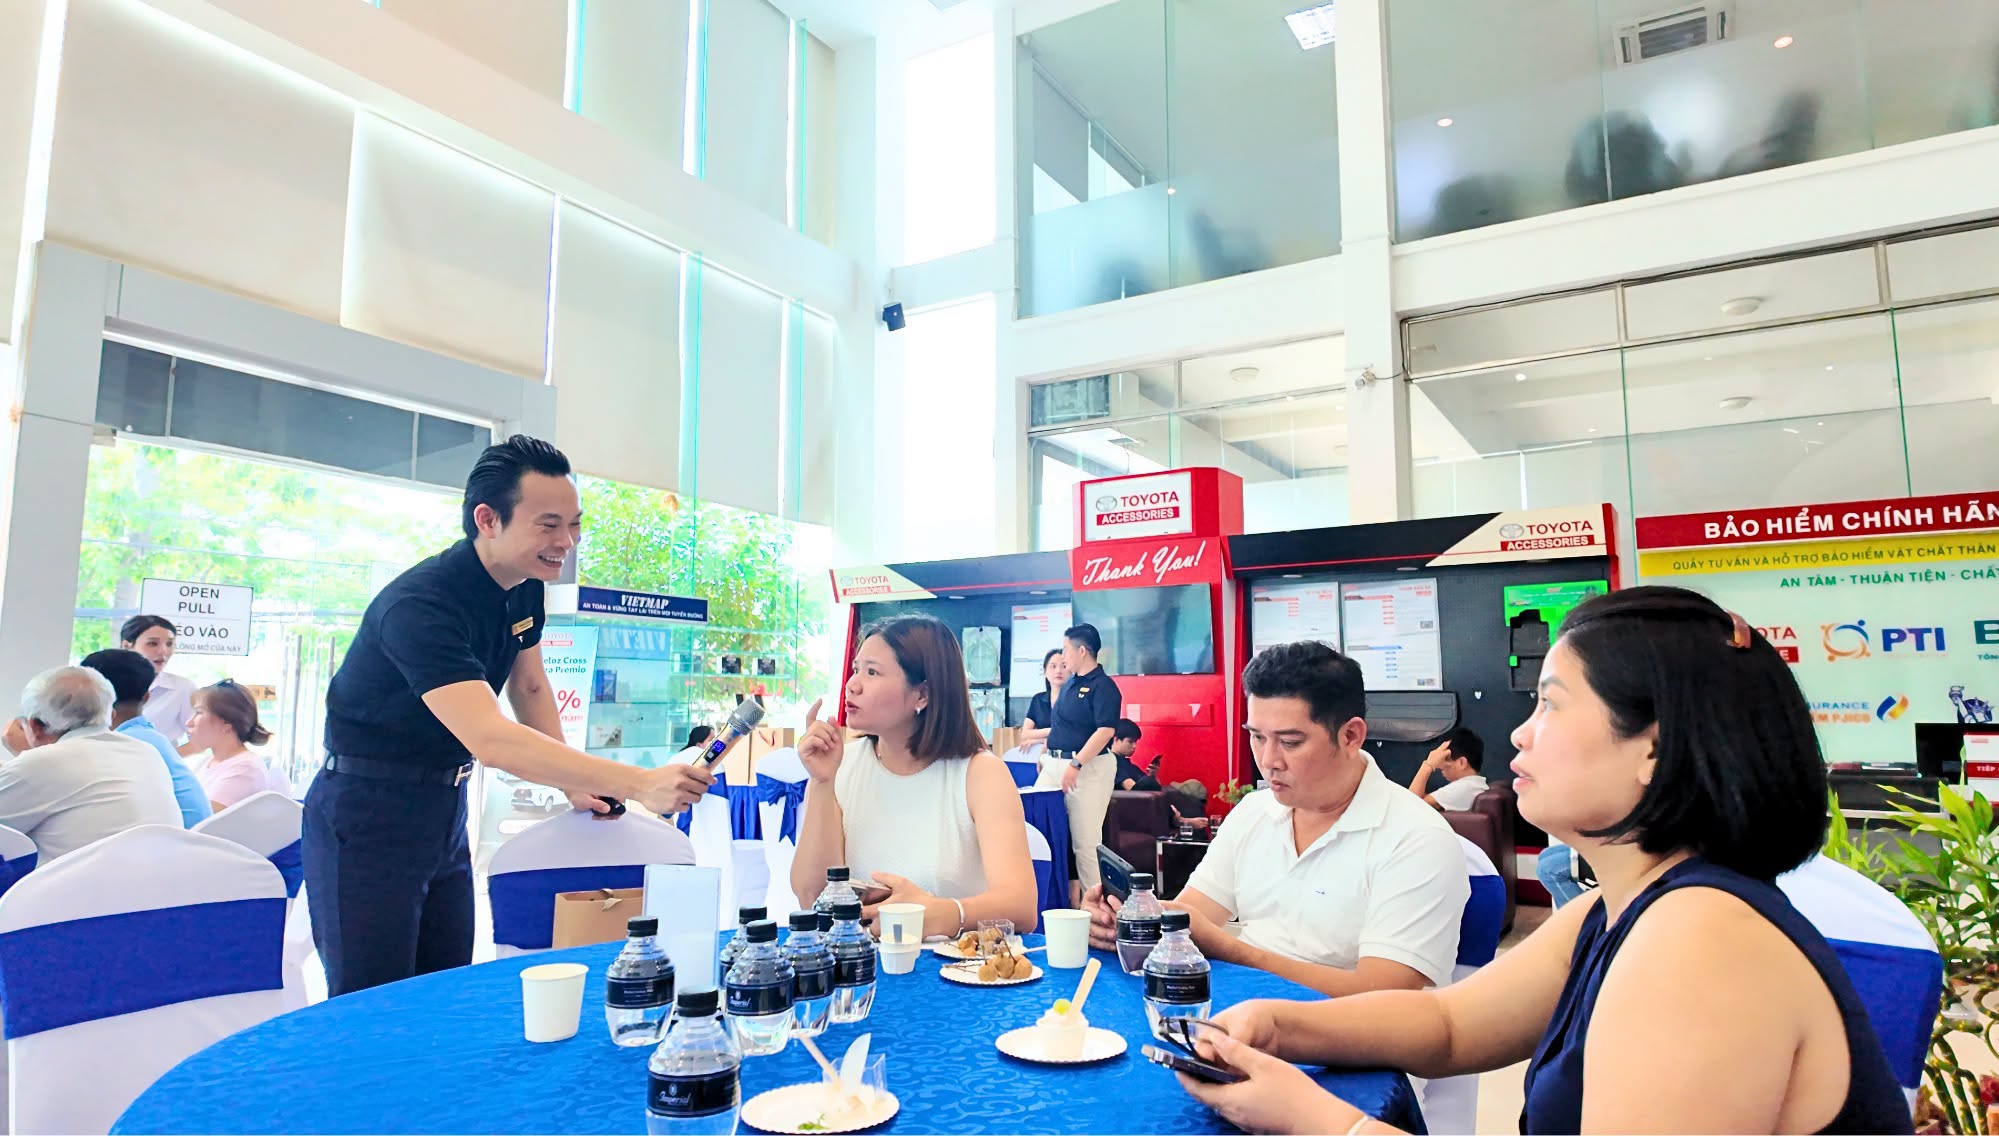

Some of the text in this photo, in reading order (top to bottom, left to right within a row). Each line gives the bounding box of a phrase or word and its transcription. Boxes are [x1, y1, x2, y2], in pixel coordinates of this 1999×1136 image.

[1120, 491, 1179, 507] TOYOTA
[1101, 508, 1174, 524] ACCESSORIES
[1704, 515, 1760, 539] BẢO
[1766, 507, 1834, 535] HIỂM
[1841, 506, 1934, 530] CHÍNH
[1526, 520, 1593, 535] TOYOTA
[1507, 536, 1589, 550] ACCESSORIES
[1852, 546, 1884, 560] HIỂM
[1958, 542, 1996, 555] THÂN
[1082, 540, 1207, 586] Thank You!
[855, 575, 889, 585] TOYOTA
[1780, 578, 1801, 588] AN
[1807, 574, 1837, 587] TÂM
[1909, 568, 1946, 584] TIỆN
[179, 585, 220, 599] OPEN
[845, 586, 888, 596] ACCESSORIES
[178, 601, 216, 615] PULL
[621, 594, 669, 610] VIETMAP
[175, 622, 229, 639] ÉO VÀO
[1881, 627, 1946, 652] PTI
[543, 655, 587, 665] eloz Cross
[555, 665, 587, 674] Premio
